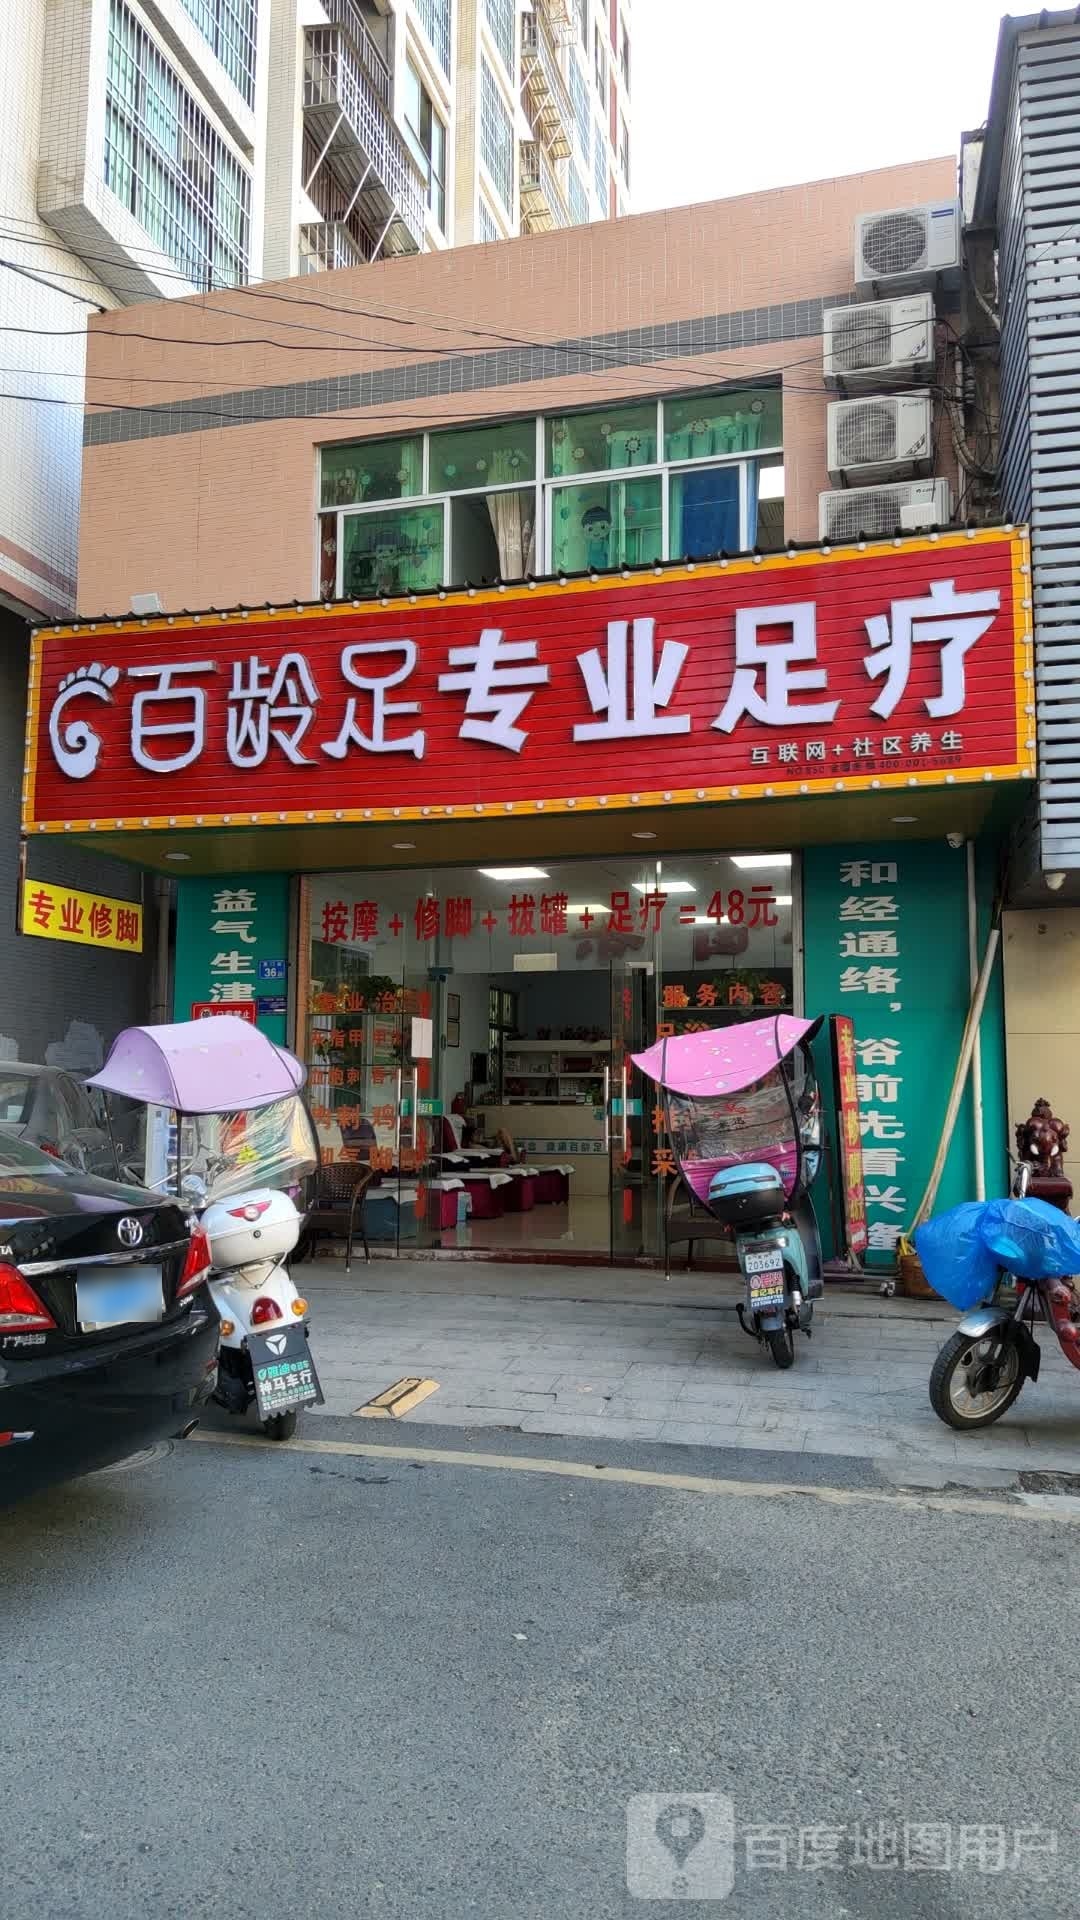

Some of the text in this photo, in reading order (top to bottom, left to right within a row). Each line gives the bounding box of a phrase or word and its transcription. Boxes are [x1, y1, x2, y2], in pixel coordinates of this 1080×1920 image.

[751, 730, 964, 765] 互联网+社区养生
[28, 889, 139, 945] 专业修脚
[662, 982, 786, 1008] 服务内容
[748, 1258, 781, 1271] 203692
[259, 1369, 312, 1396] 神马车行
